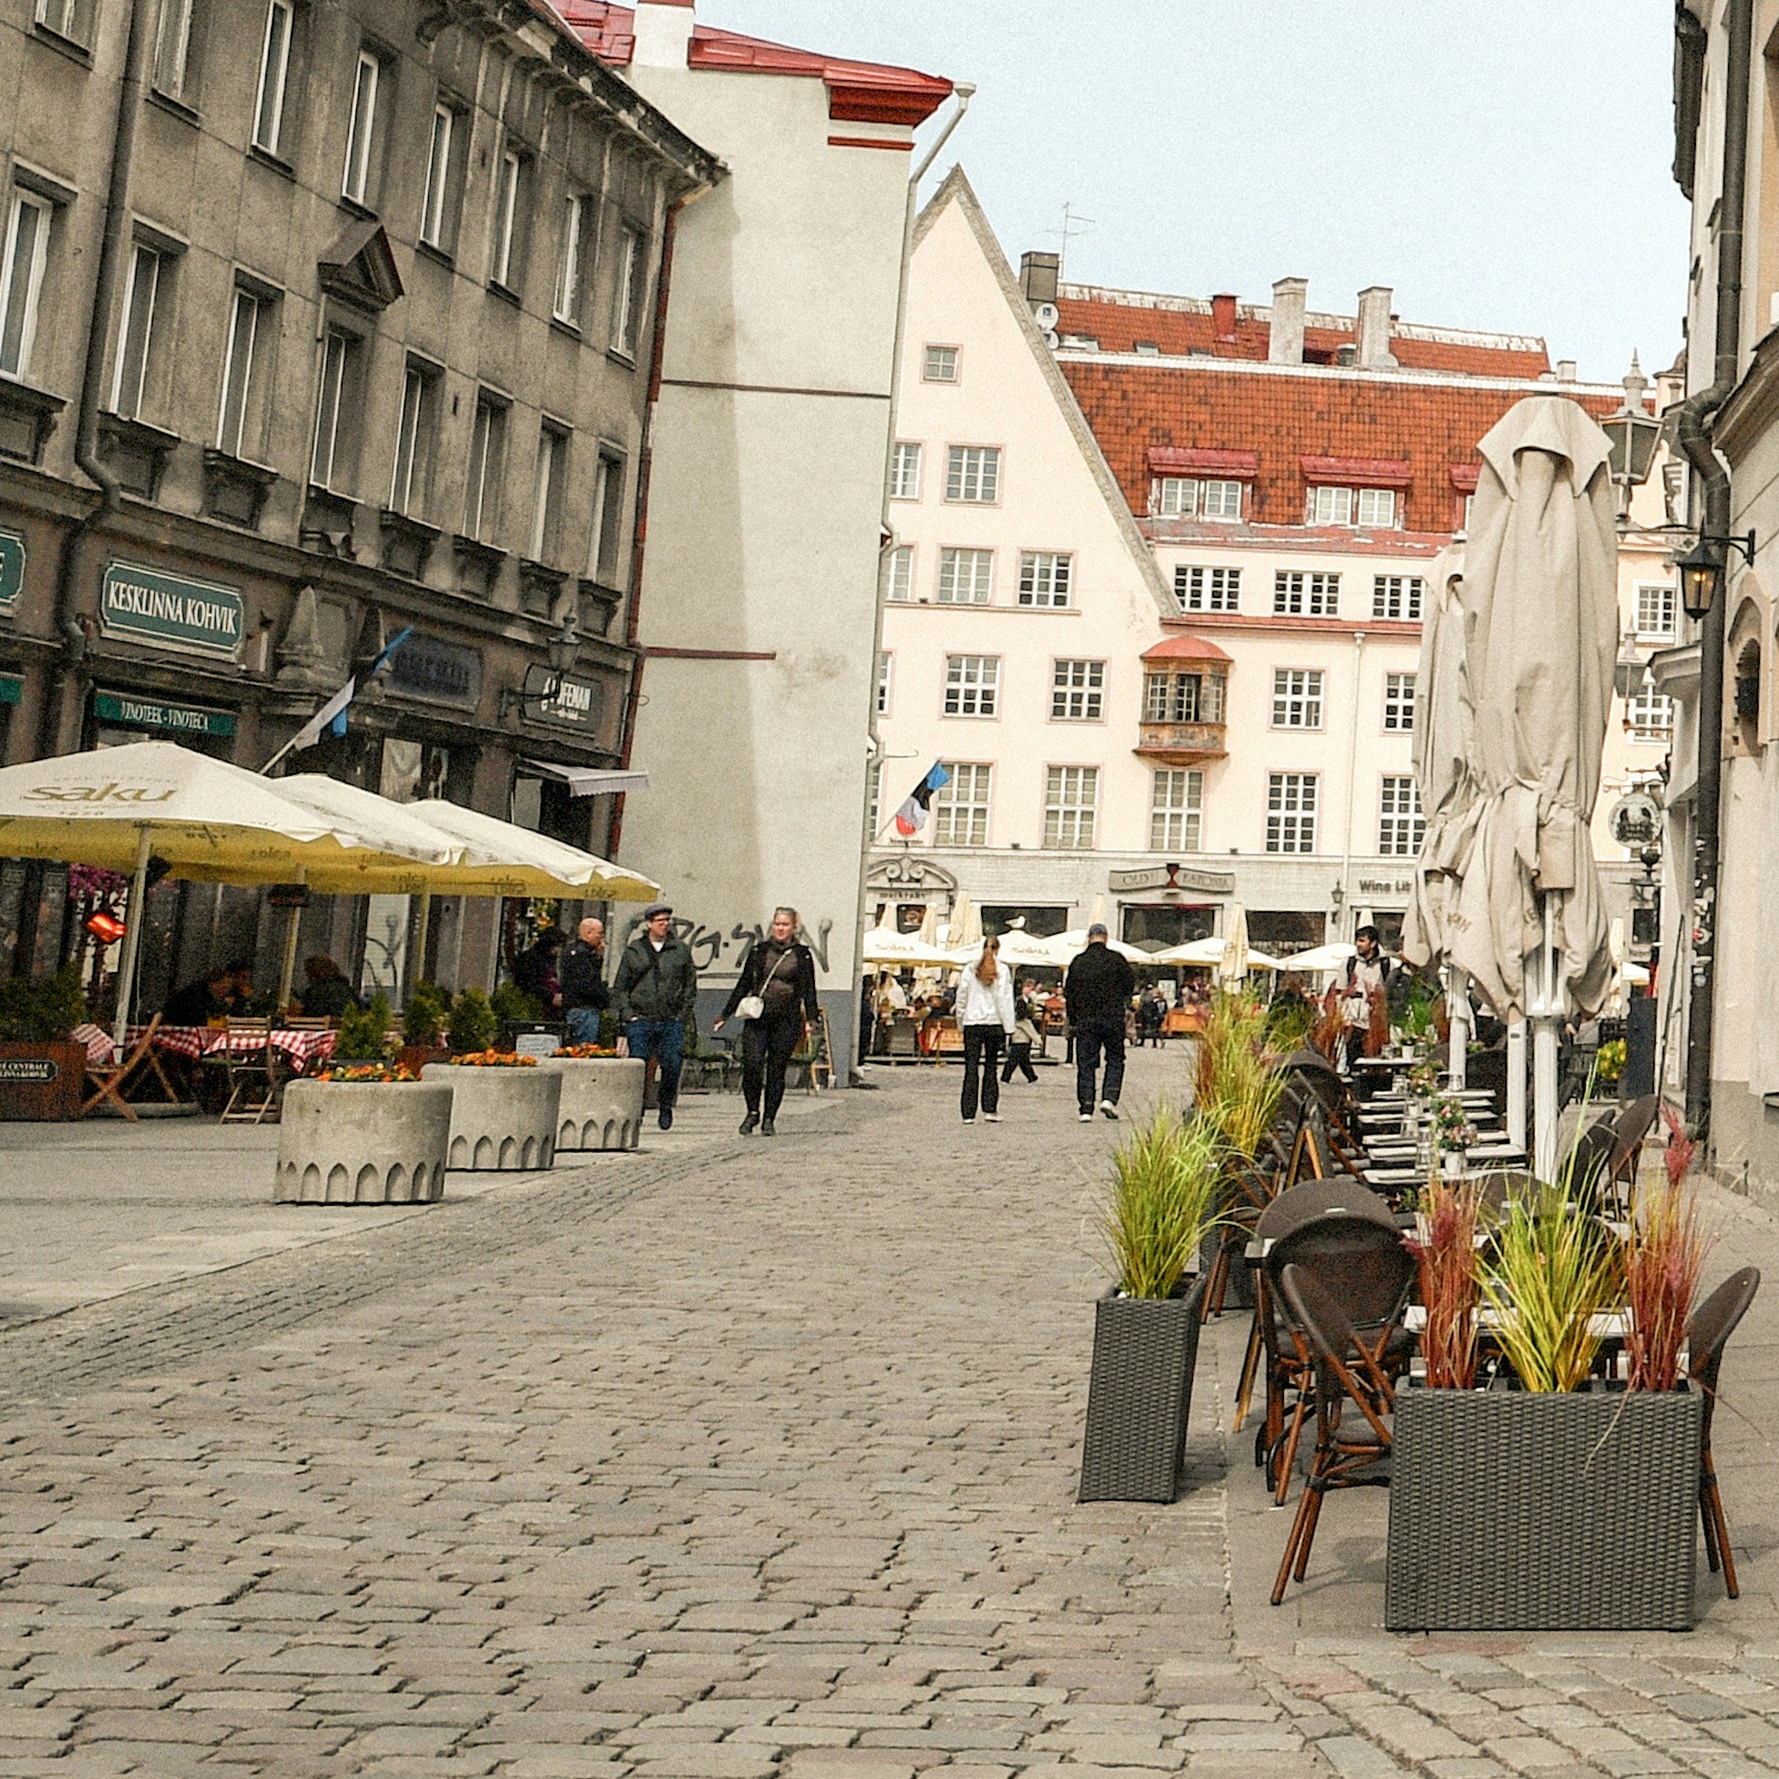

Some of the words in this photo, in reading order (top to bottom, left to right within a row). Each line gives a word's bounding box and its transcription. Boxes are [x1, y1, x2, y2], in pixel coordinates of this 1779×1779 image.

[108, 580, 184, 626] KESKLINNA
[185, 598, 238, 635] KOHVIK
[22, 782, 177, 801] saku
[1359, 879, 1391, 895] Wine
